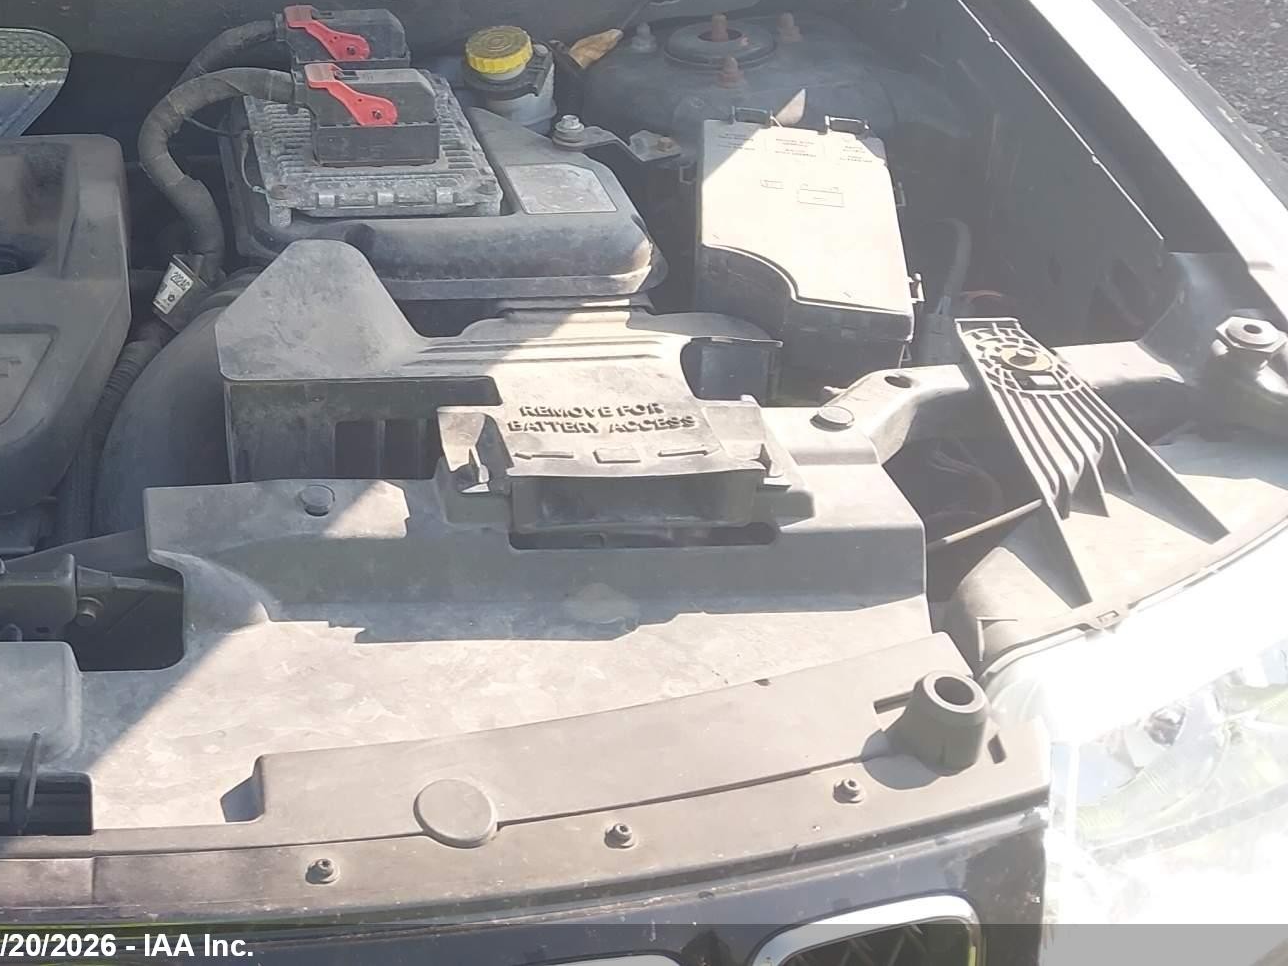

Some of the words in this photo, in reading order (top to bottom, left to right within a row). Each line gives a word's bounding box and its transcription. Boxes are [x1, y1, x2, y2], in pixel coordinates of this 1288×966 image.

[518, 404, 613, 419] REMOVE
[615, 401, 666, 417] FOR
[506, 419, 601, 434] BATTERY
[608, 414, 697, 434] ACCESS
